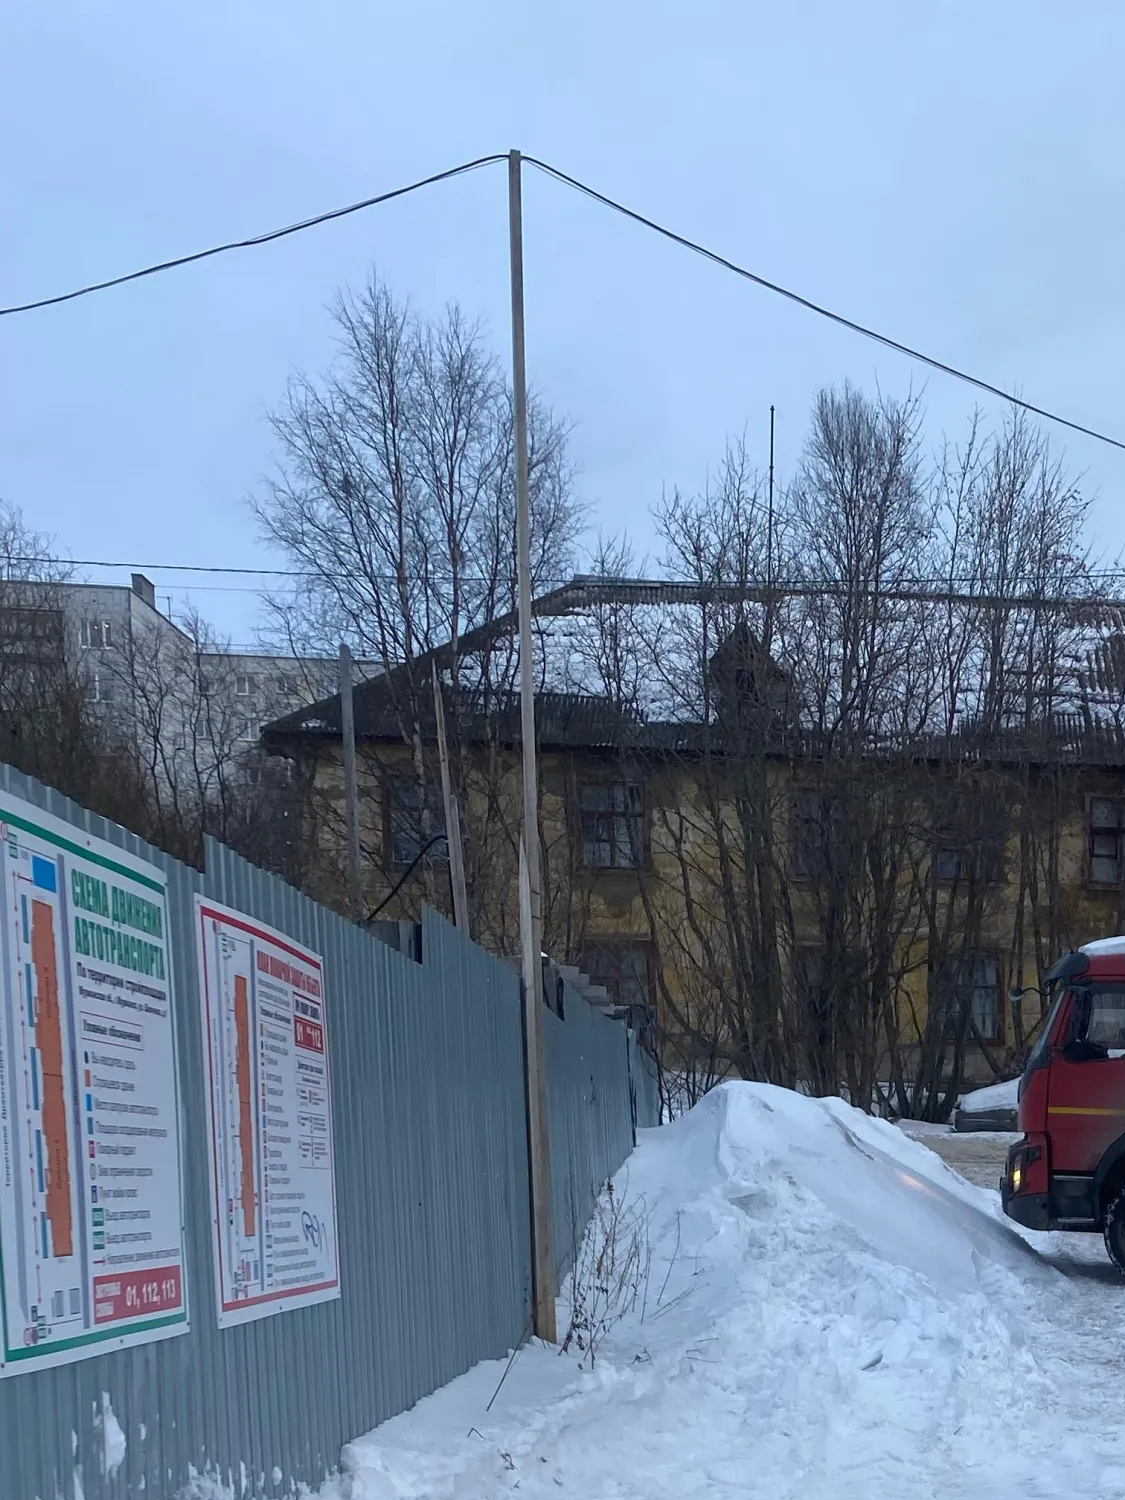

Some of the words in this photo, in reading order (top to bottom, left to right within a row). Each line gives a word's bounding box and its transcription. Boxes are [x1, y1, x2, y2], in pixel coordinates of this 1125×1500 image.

[71, 868, 110, 919] СХЕМА
[111, 885, 163, 940] ДВИЖЕНИЯ
[74, 915, 165, 981] АВТОТРАНСПОРТА
[125, 1285, 140, 1310] 01,
[142, 1281, 160, 1306] 112,
[162, 1278, 176, 1301] 113
